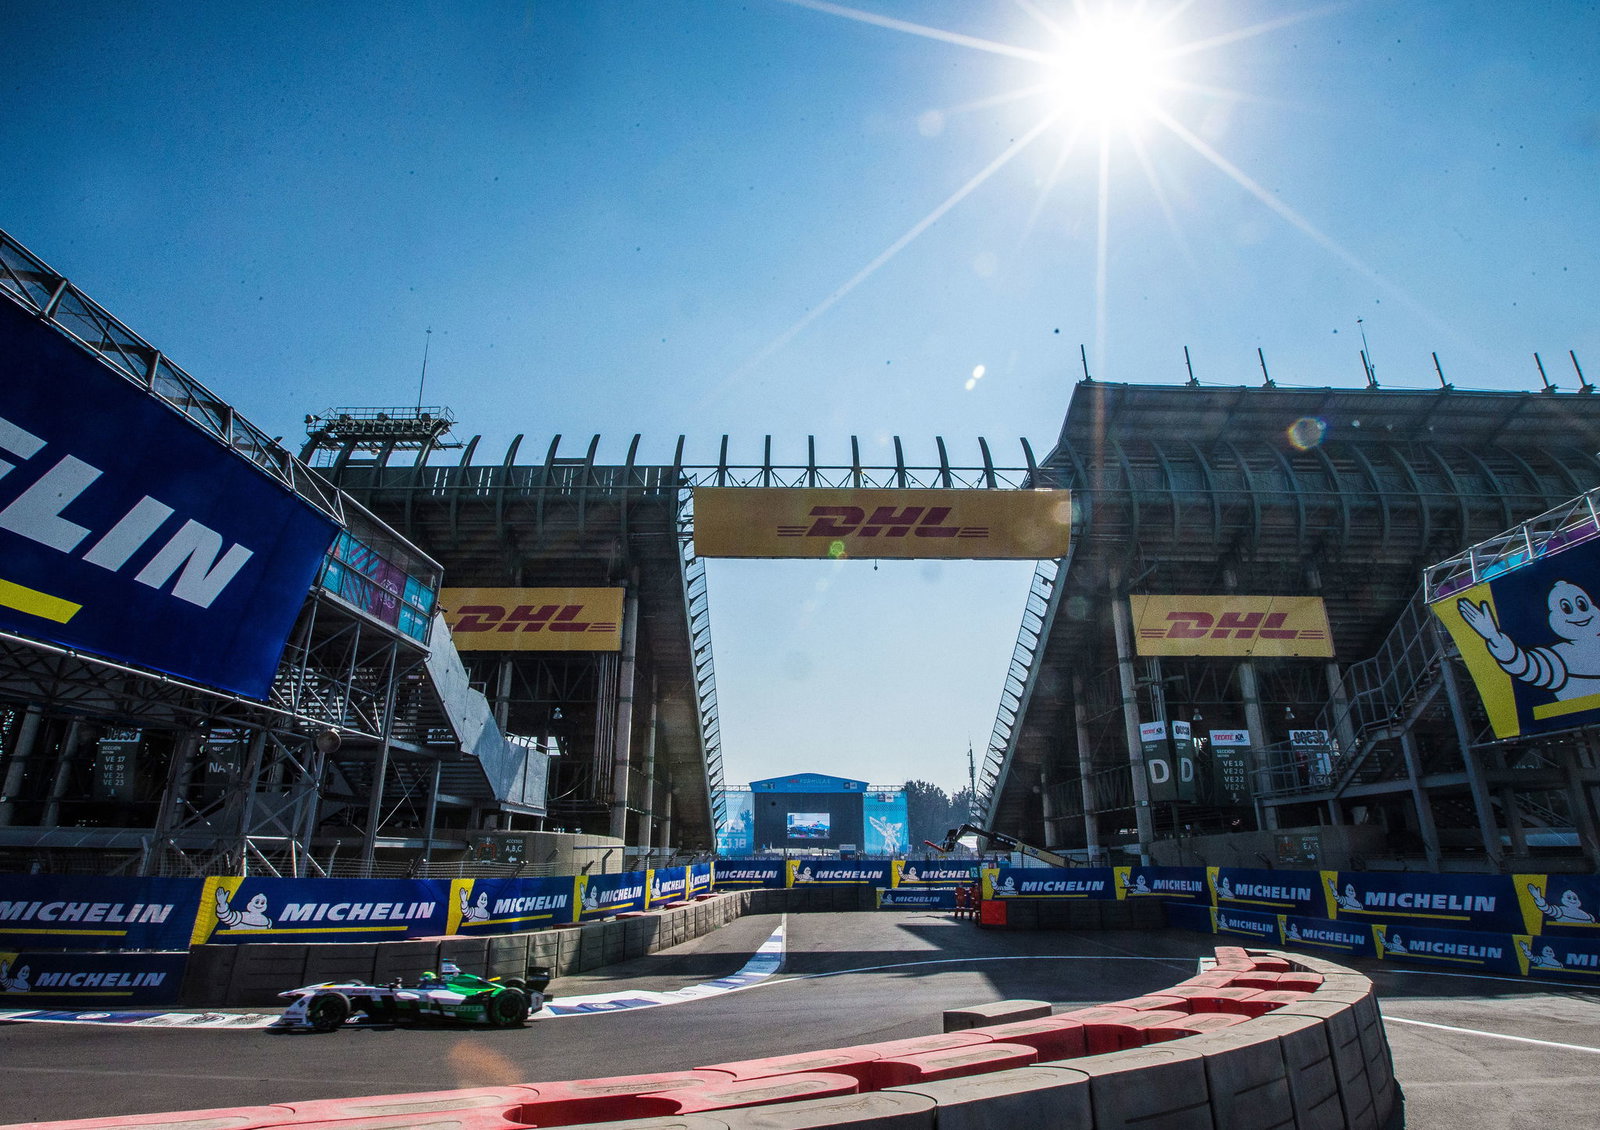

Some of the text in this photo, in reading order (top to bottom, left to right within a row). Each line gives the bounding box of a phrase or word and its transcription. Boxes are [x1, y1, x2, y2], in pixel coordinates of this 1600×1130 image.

[0, 417, 254, 609] LIN
[805, 506, 961, 538] DHL
[451, 604, 592, 632] DHL
[1166, 611, 1299, 639] DHL
[1149, 759, 1169, 784] D
[1181, 757, 1193, 782] D
[715, 870, 778, 879] MICHELIN
[816, 870, 883, 879] MICHELIN
[920, 870, 970, 879] MICHEL
[600, 886, 642, 903] MICHELIN
[661, 879, 685, 893] MICHELIN
[1021, 880, 1104, 892] MICHELIN
[1153, 879, 1202, 892] MICHELIN
[1235, 883, 1311, 901] MICHELIN
[492, 894, 567, 914] MICHELIN
[1364, 891, 1496, 912] MICHELIN
[0, 901, 174, 924] MICHELIN
[278, 902, 436, 921] MICHELIN
[1229, 919, 1273, 933] MICHELIN
[1302, 928, 1365, 945] MICHELIN
[1409, 940, 1503, 959] MICHELIN
[1565, 953, 1600, 967] MI
[34, 972, 166, 987] MICHELIN
